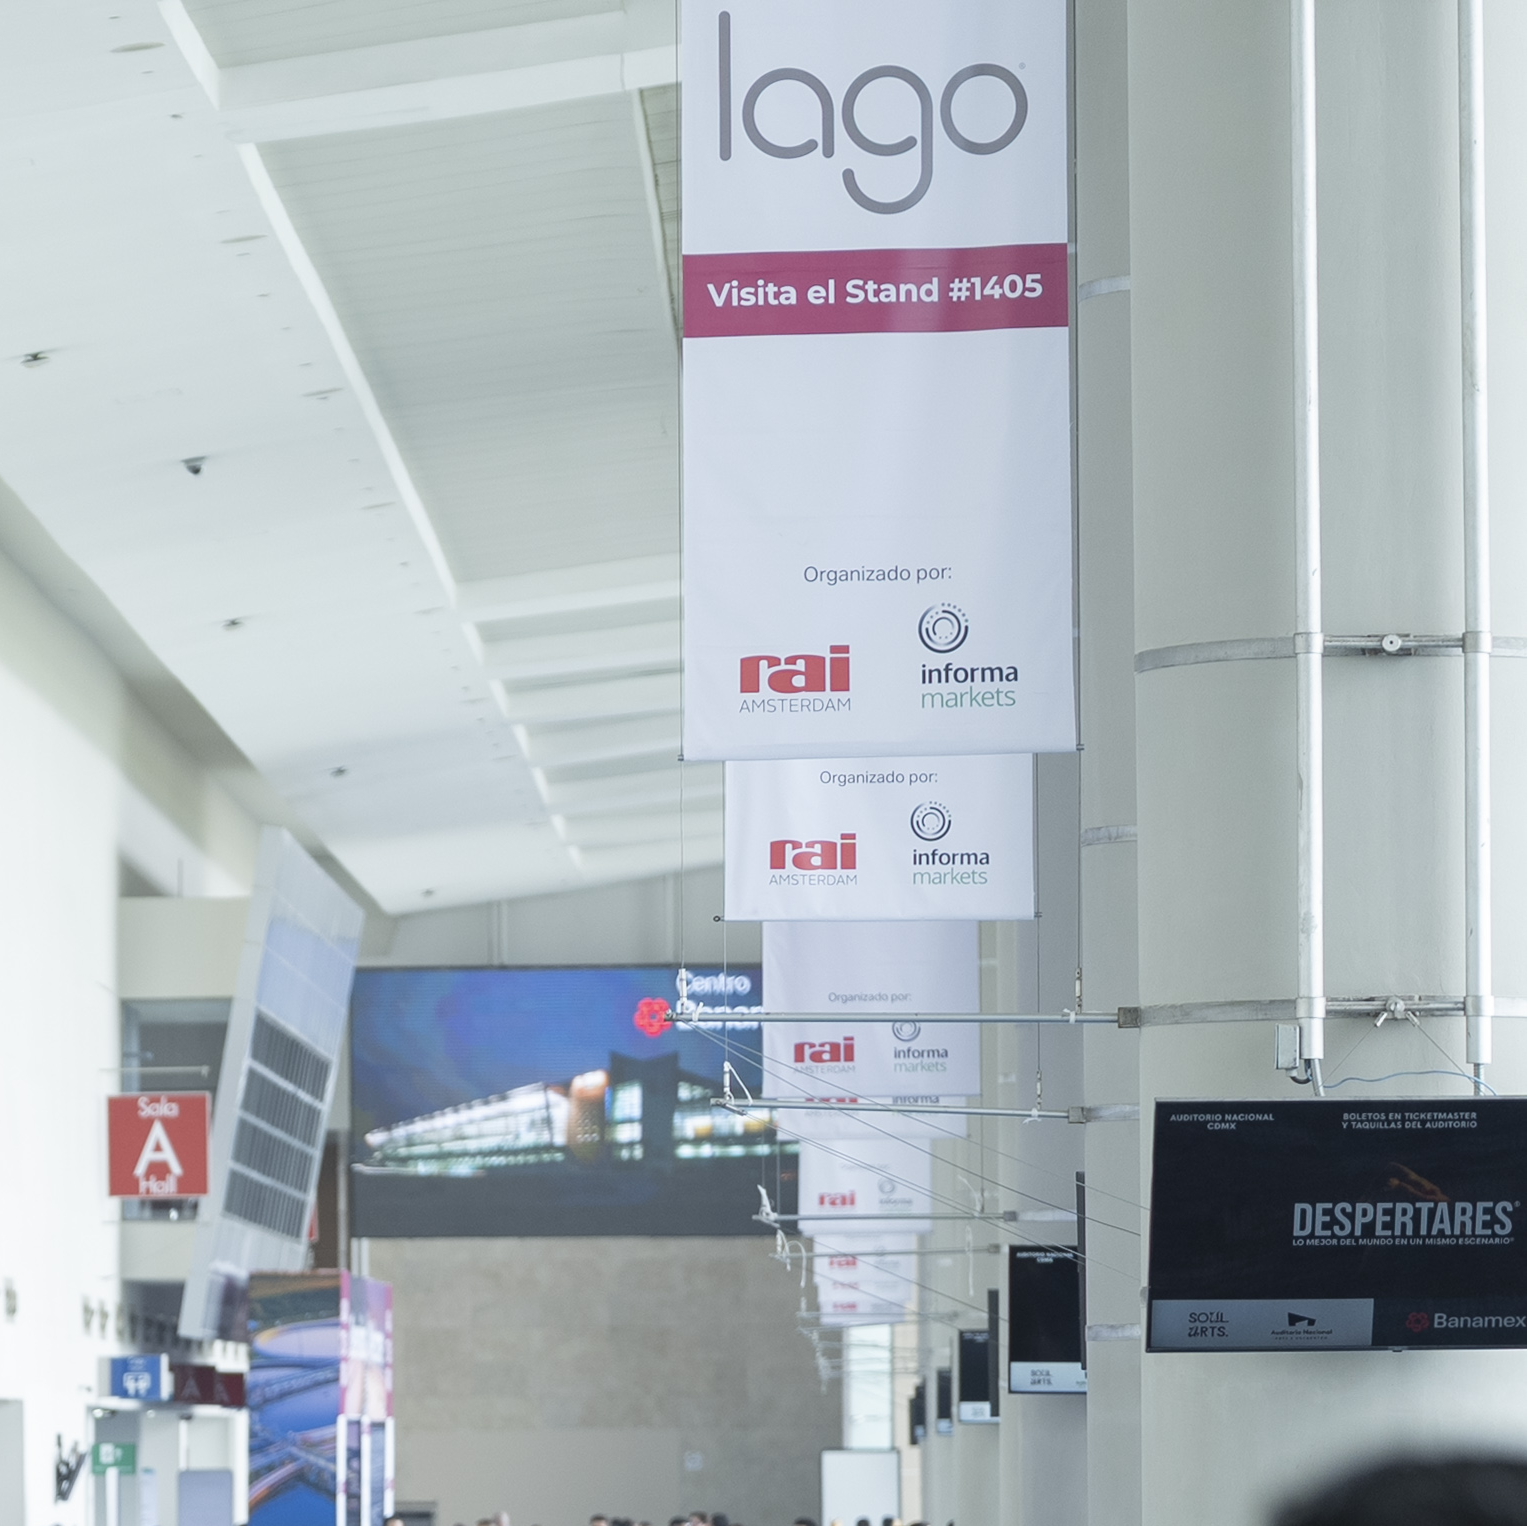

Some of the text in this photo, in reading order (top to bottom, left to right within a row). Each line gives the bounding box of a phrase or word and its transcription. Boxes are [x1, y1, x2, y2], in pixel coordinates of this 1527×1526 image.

[719, 10, 1028, 214] lago
[707, 273, 1043, 308] Visita el Stand #1405
[803, 564, 952, 586] Organizado por:
[739, 645, 850, 694] rai
[921, 662, 1018, 686] informa
[739, 698, 851, 714] AMSTERDAM
[921, 685, 1016, 709] markets
[819, 768, 938, 788] Organizado por:
[769, 832, 857, 871] rai
[912, 847, 990, 867] informa
[769, 874, 858, 886] AMSTERDAM
[912, 866, 988, 886] markets
[676, 971, 752, 996] Centro
[828, 992, 912, 1003] Organizado por:
[794, 1036, 855, 1063] rai
[893, 1046, 948, 1059] informa
[794, 1065, 856, 1074] AMSTERDAM
[893, 1060, 947, 1073] markets
[138, 1097, 179, 1119] Sala
[1170, 1113, 1275, 1122] AUDITORIO NACIONAL
[1343, 1112, 1477, 1120] BOLETOS EN TICKETMASTER
[1207, 1122, 1236, 1130] CDMX
[1342, 1120, 1477, 1130] Y TAQUILLAS DEL AUDITORIO
[133, 1118, 183, 1177] A
[139, 1174, 178, 1195] Hall
[1292, 1201, 1514, 1237] DESPERTARES
[1292, 1238, 1304, 1246] LO
[1306, 1238, 1338, 1246] MEJOR
[1340, 1238, 1356, 1246] DEL
[1358, 1238, 1393, 1246] MUNDO
[1395, 1237, 1408, 1245] EN
[1410, 1237, 1423, 1245] UN
[1425, 1237, 1457, 1245] MISMO
[1434, 1313, 1527, 1329] Banamex
